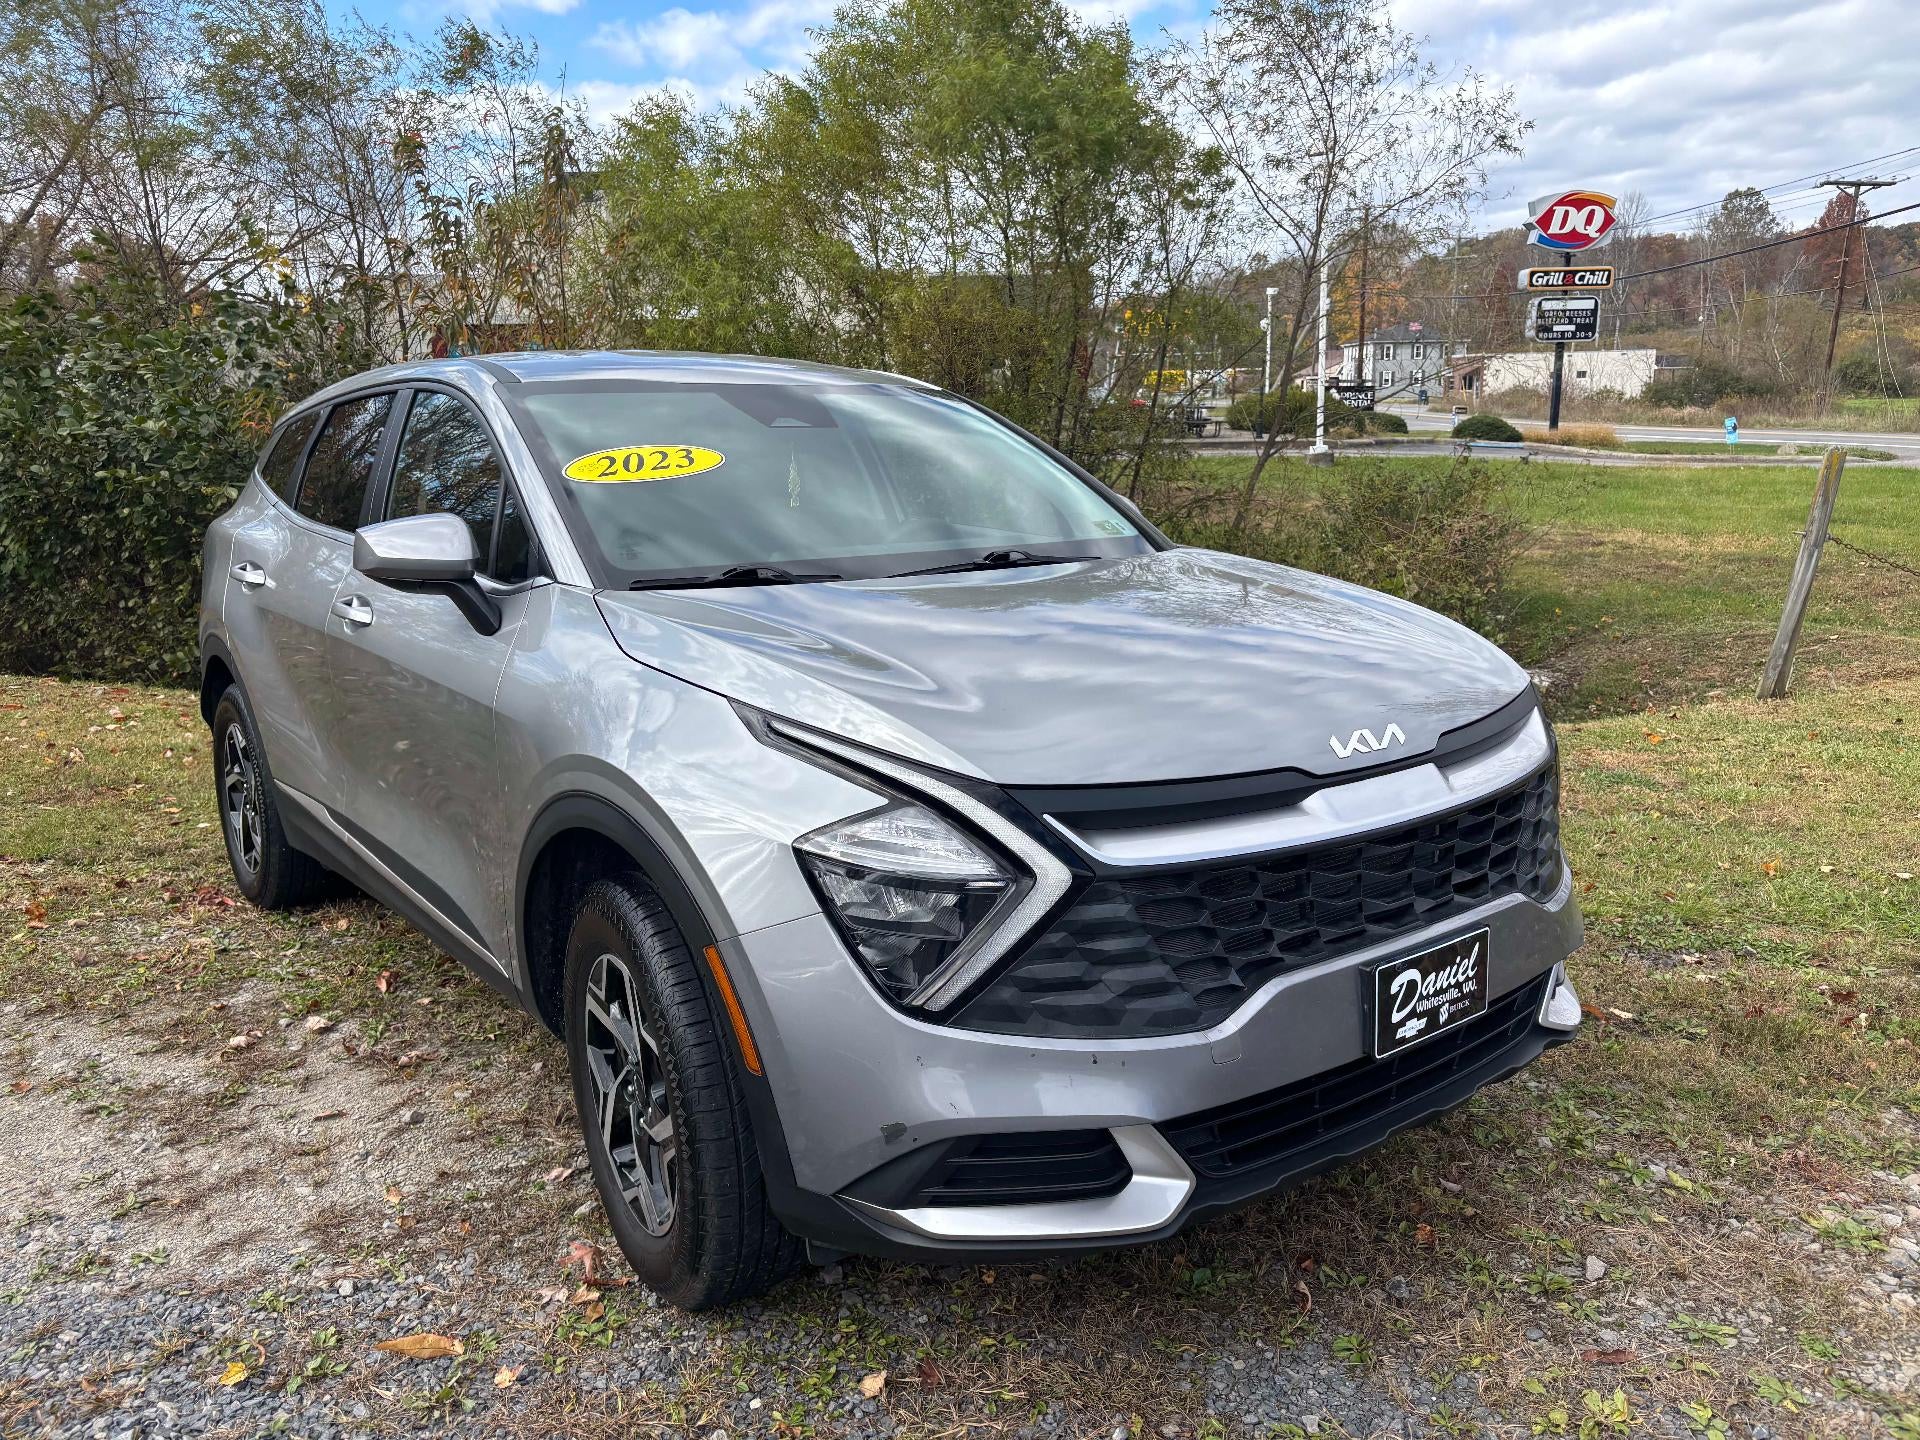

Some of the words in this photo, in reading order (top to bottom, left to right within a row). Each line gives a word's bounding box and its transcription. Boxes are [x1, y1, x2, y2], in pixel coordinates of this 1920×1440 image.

[1547, 205, 1605, 238] DQ
[1532, 271, 1564, 286] Grill
[1574, 271, 1608, 285] Chill
[1538, 331, 1561, 339] HOURS
[597, 448, 695, 478] 2023
[1390, 941, 1480, 1024] Daniel
[1449, 998, 1470, 1013] BUICK
